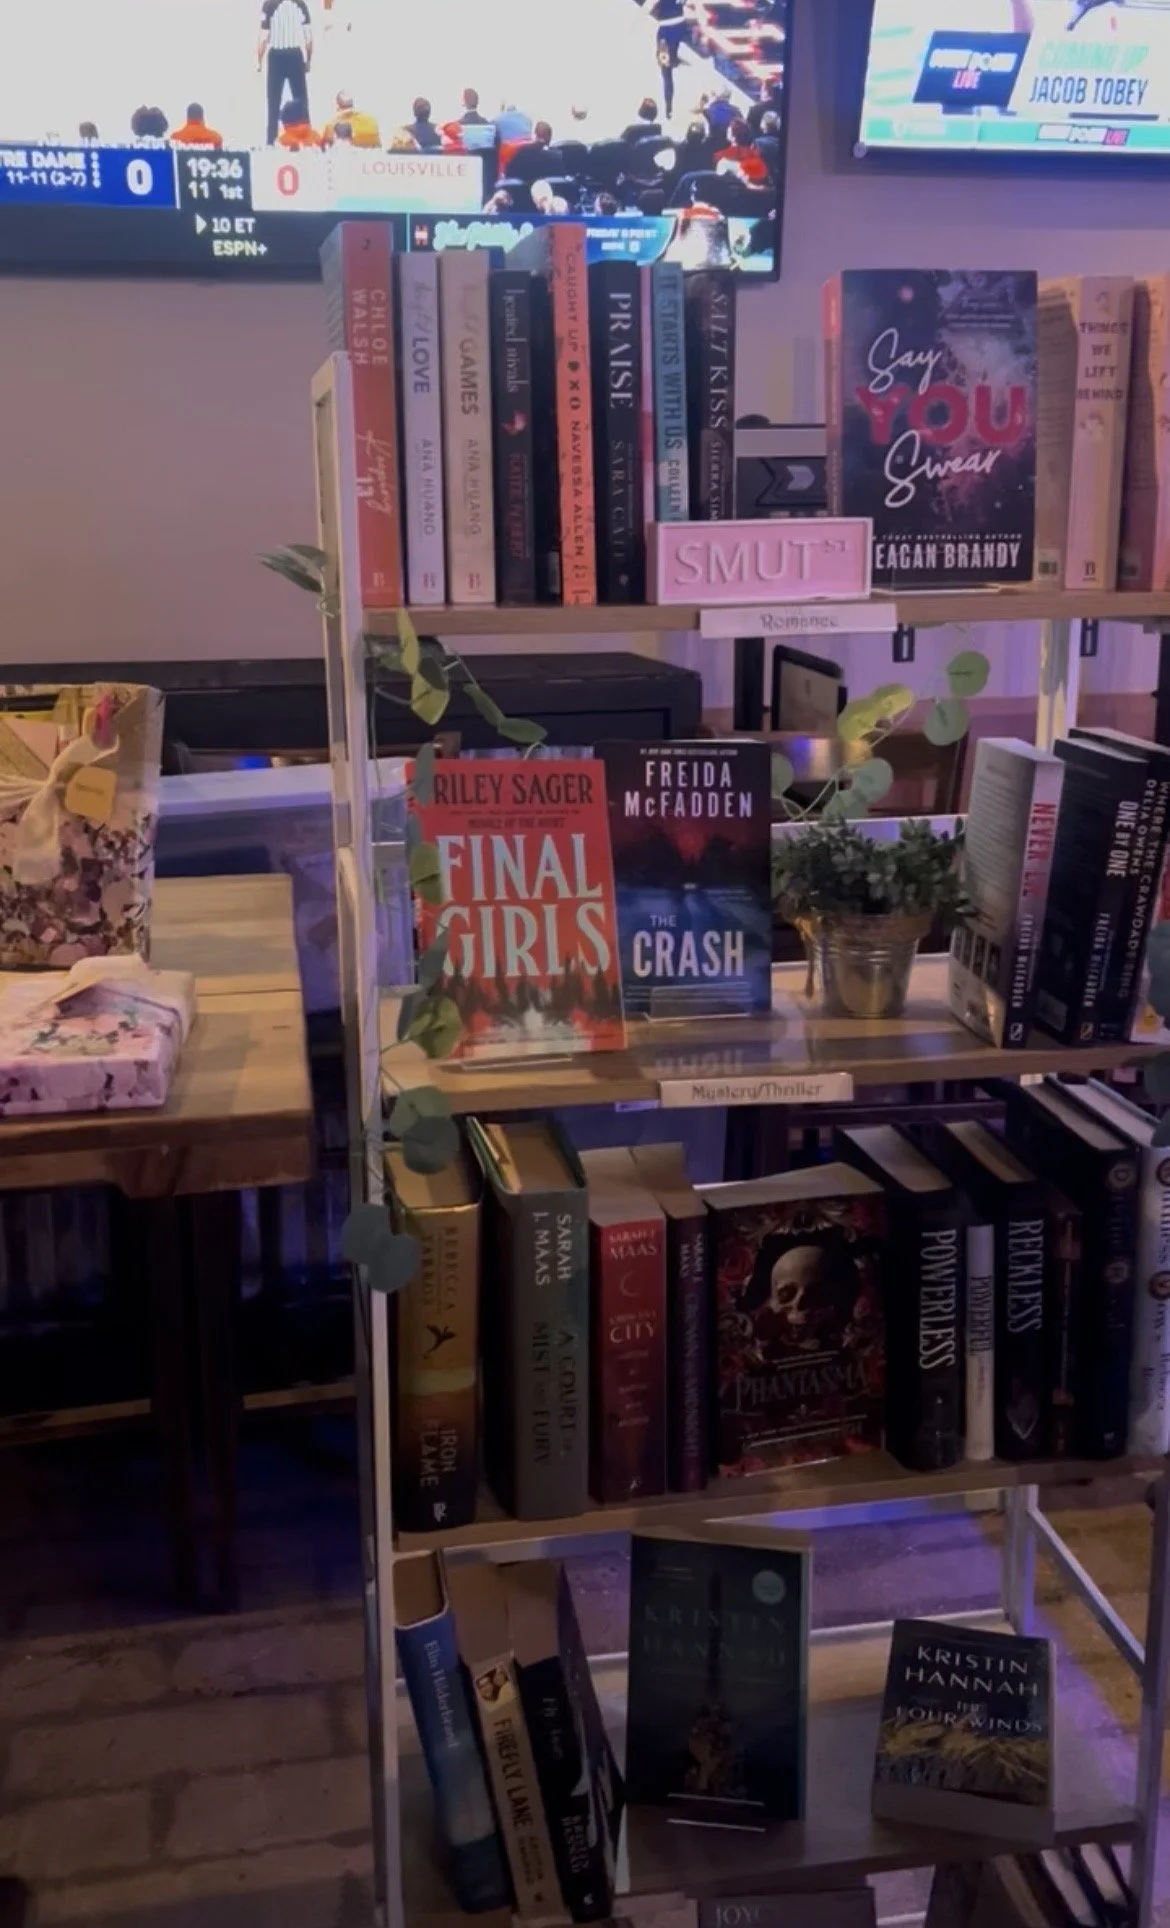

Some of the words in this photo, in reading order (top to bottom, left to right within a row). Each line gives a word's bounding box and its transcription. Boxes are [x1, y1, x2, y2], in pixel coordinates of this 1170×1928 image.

[950, 69, 980, 90] LIVE
[1029, 76, 1088, 104] JACOB
[1093, 78, 1149, 105] TOBEY
[31, 150, 86, 170] DAME
[126, 160, 153, 195] 0
[186, 157, 243, 178] 19:36
[362, 161, 467, 178] LOUISVILLE
[188, 181, 210, 199] 11
[219, 184, 244, 200] 1st
[277, 164, 300, 196] 0
[212, 217, 231, 234] 10
[235, 217, 256, 234] ET
[213, 240, 268, 256] ESPN+
[566, 252, 580, 323] CAUGHT
[352, 288, 369, 366] WALSH
[370, 288, 388, 366] CHLOE
[567, 328, 579, 352] UP
[661, 299, 680, 366] STARTS
[1079, 321, 1128, 334] THINGS
[412, 336, 431, 394] LOVE
[609, 292, 633, 409] PRAISE
[868, 328, 942, 394] Say
[1092, 344, 1112, 356] WE
[459, 339, 479, 417] GAMES
[1085, 366, 1117, 378] LEFT
[663, 371, 682, 420] WITH
[709, 365, 729, 429] KISS
[1077, 388, 1125, 400] BEHIND
[854, 384, 1028, 447] YOU
[421, 438, 436, 472] ANA
[466, 438, 481, 472] ANA
[665, 425, 684, 451] US
[667, 458, 682, 515] COLLEEN
[884, 430, 1002, 508] Swear
[421, 478, 437, 536] HUANG
[467, 478, 483, 536] HUANG
[709, 495, 721, 521] SIM
[573, 503, 585, 556] ALLEN
[674, 539, 819, 586] SMUT
[874, 543, 937, 569] EAGAN
[943, 542, 1021, 569] BRANDY
[759, 613, 839, 631] Romance
[434, 773, 503, 805] RILEY
[511, 773, 594, 805] SAGER
[645, 760, 732, 788] FREIDA
[624, 790, 753, 818] McFADDEN
[1115, 800, 1139, 830] ONE
[1139, 779, 1158, 821] DELIA
[1150, 780, 1170, 833] WHERE
[1027, 803, 1057, 860] NEVER
[1113, 832, 1132, 848] BY
[436, 833, 603, 902] FINAL
[1105, 849, 1131, 878] ONE
[1129, 825, 1148, 877] OWENS
[1143, 839, 1161, 868] THE
[650, 915, 677, 927] THE
[437, 902, 610, 978] GIRLS
[633, 930, 745, 978] CRASH
[692, 1082, 823, 1101] Mystery/Thriller
[533, 1228, 552, 1287] MAAS
[556, 1213, 573, 1281] SARAH
[1007, 1218, 1045, 1334] RECKLESS
[918, 1228, 958, 1371] POWERLESS
[532, 1322, 551, 1373] MIST
[558, 1331, 575, 1347] A
[610, 1321, 656, 1344] CITY
[558, 1356, 577, 1433] COURT
[735, 1361, 870, 1411] PHANTASMA
[418, 1418, 440, 1491] FLAME
[438, 1427, 460, 1473] IRON
[532, 1408, 551, 1467] FURY
[917, 1645, 1029, 1674] KRISTIN
[904, 1666, 1039, 1697] HANNAH
[895, 1705, 958, 1727] FOUR
[971, 1716, 1043, 1733] WINDS
[494, 1718, 523, 1782] FIREFLY
